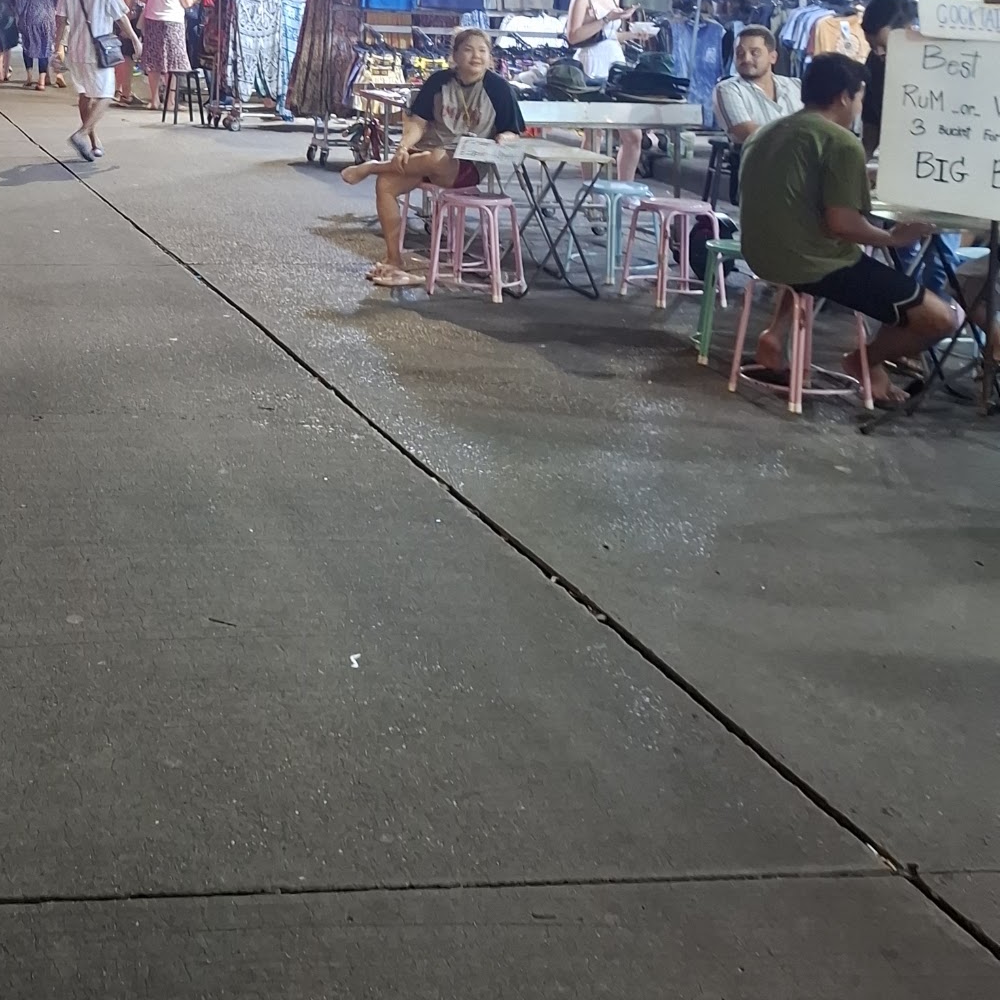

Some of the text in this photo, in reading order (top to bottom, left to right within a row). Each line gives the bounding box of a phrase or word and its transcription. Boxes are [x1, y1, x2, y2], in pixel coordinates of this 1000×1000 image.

[922, 44, 982, 79] Best
[909, 118, 927, 136] 3
[916, 150, 970, 184] BIG
